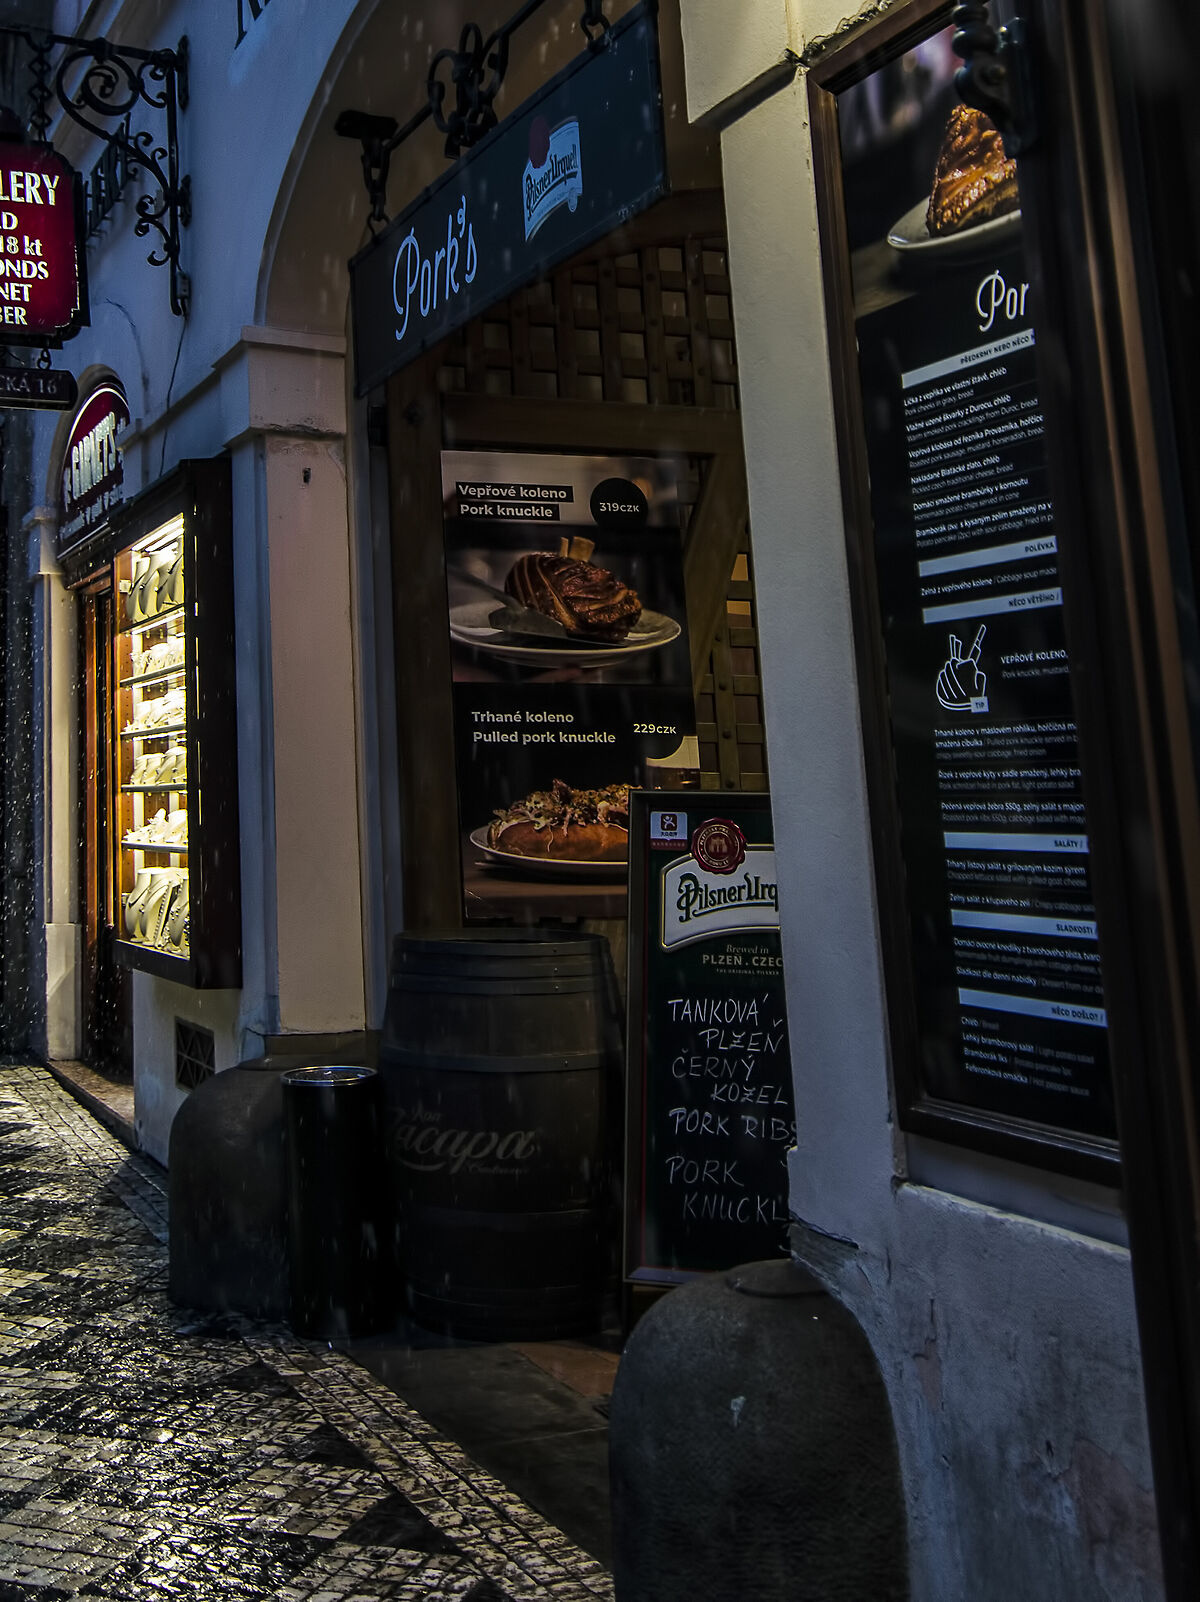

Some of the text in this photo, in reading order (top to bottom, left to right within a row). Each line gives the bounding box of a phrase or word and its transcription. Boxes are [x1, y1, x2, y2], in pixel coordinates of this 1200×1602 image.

[23, 234, 43, 257] kt
[392, 194, 479, 341] Pork's
[975, 268, 1030, 333] Por
[37, 375, 58, 395] 16
[458, 484, 567, 499] Vepřové koleno
[460, 503, 553, 518] Pork knuckle
[471, 710, 574, 724] Trhané koleno
[473, 731, 616, 746] Pulled pork knuckle
[676, 872, 779, 923] Pilsner Urq
[702, 953, 782, 967] PLZEŇ CZEC
[667, 993, 769, 1027] TANKOVÁ
[671, 1047, 756, 1082] ČERNÝ
[668, 1106, 731, 1137] PORK
[664, 1154, 745, 1188] PORK
[682, 1190, 788, 1225] KNUCKL
